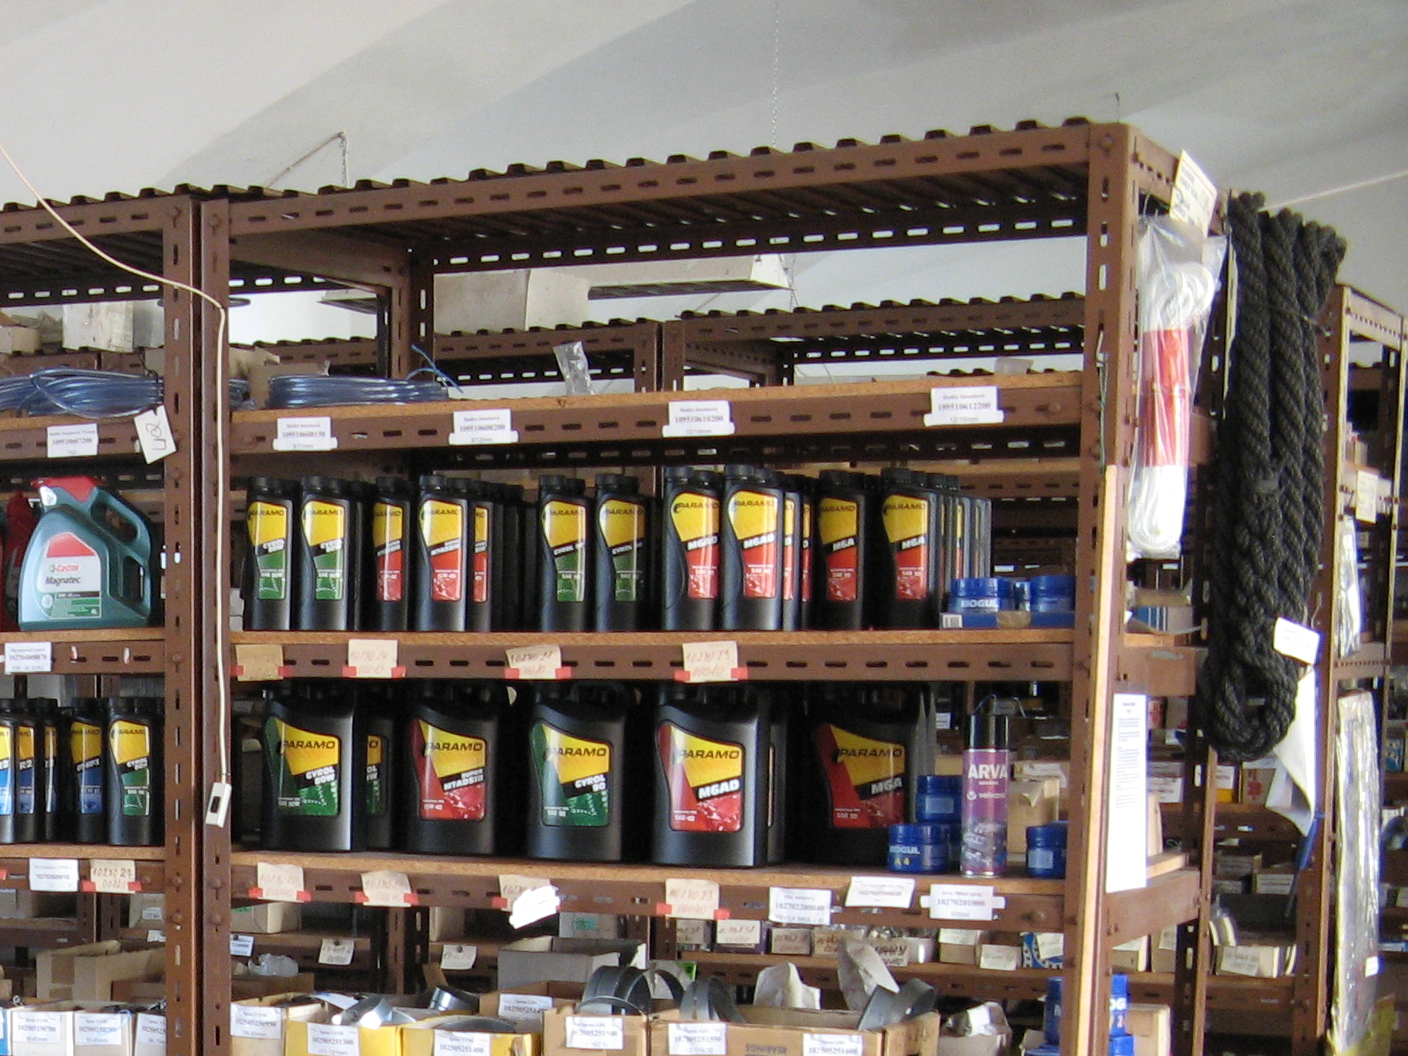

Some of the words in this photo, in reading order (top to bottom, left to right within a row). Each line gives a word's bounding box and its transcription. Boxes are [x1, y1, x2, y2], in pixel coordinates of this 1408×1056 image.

[960, 599, 999, 609] MOGUL
[282, 740, 335, 750] PARAMO
[551, 747, 607, 757] PARAMO
[681, 749, 740, 760] PARAMO
[840, 748, 902, 758] PARAMO
[305, 765, 336, 780] GYROL
[968, 764, 1008, 779] ARVA
[575, 774, 606, 788] GYROL
[871, 777, 903, 795] M6A
[698, 778, 741, 799] M6AD
[889, 845, 921, 855] MOGUL
